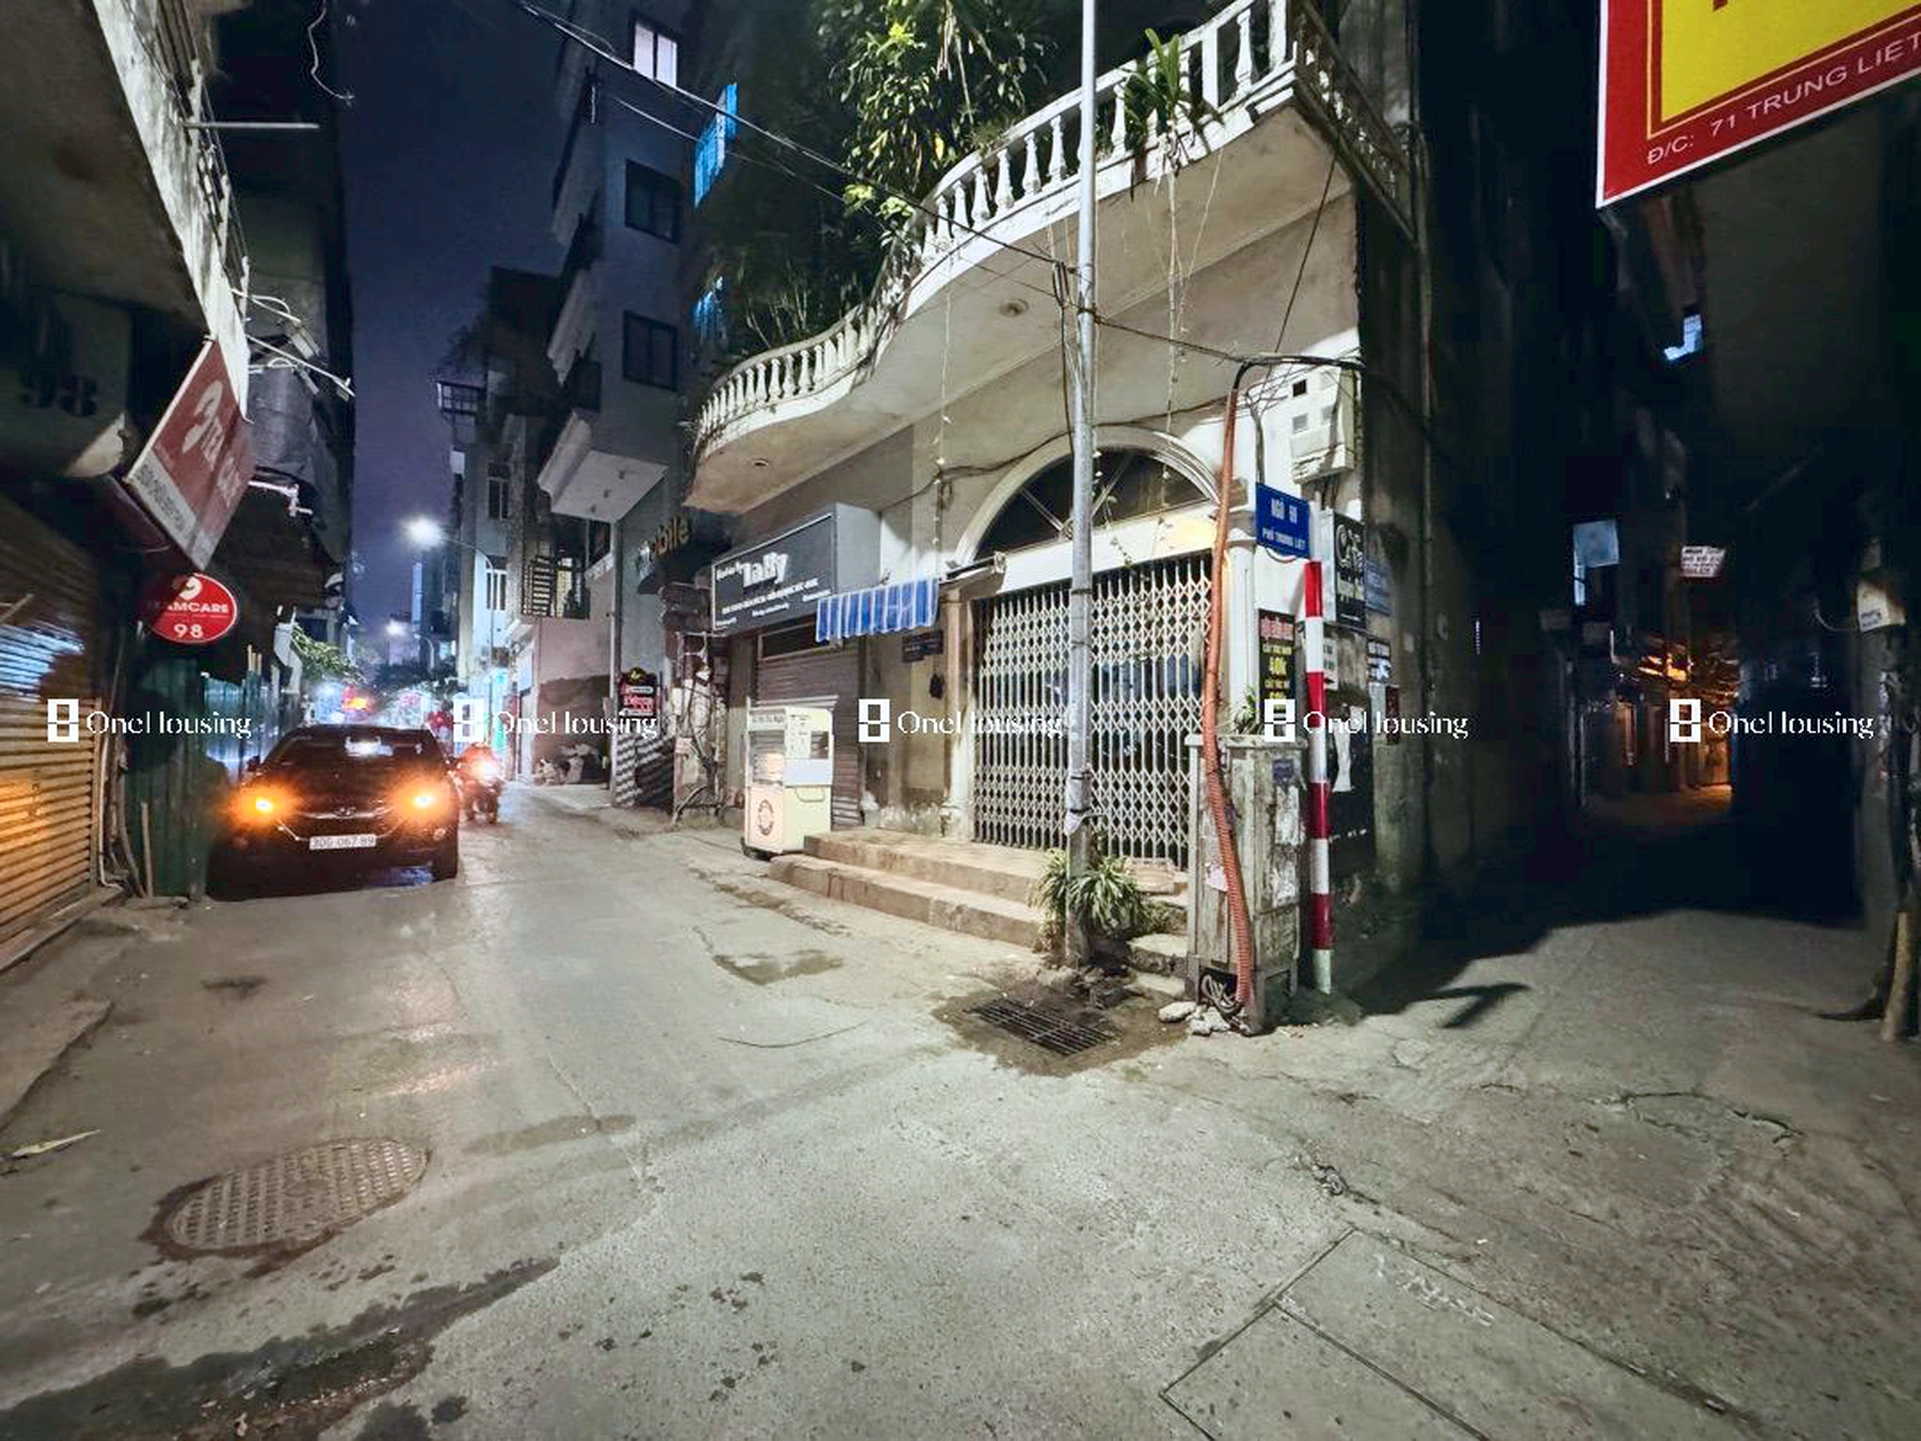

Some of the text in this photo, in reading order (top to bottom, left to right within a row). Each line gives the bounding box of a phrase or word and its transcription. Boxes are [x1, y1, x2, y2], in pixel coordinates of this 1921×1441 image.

[1646, 134, 1694, 164] Đ/C:
[1710, 116, 1736, 137] 71
[1747, 66, 1848, 121] TRUNG
[173, 623, 204, 639] 98
